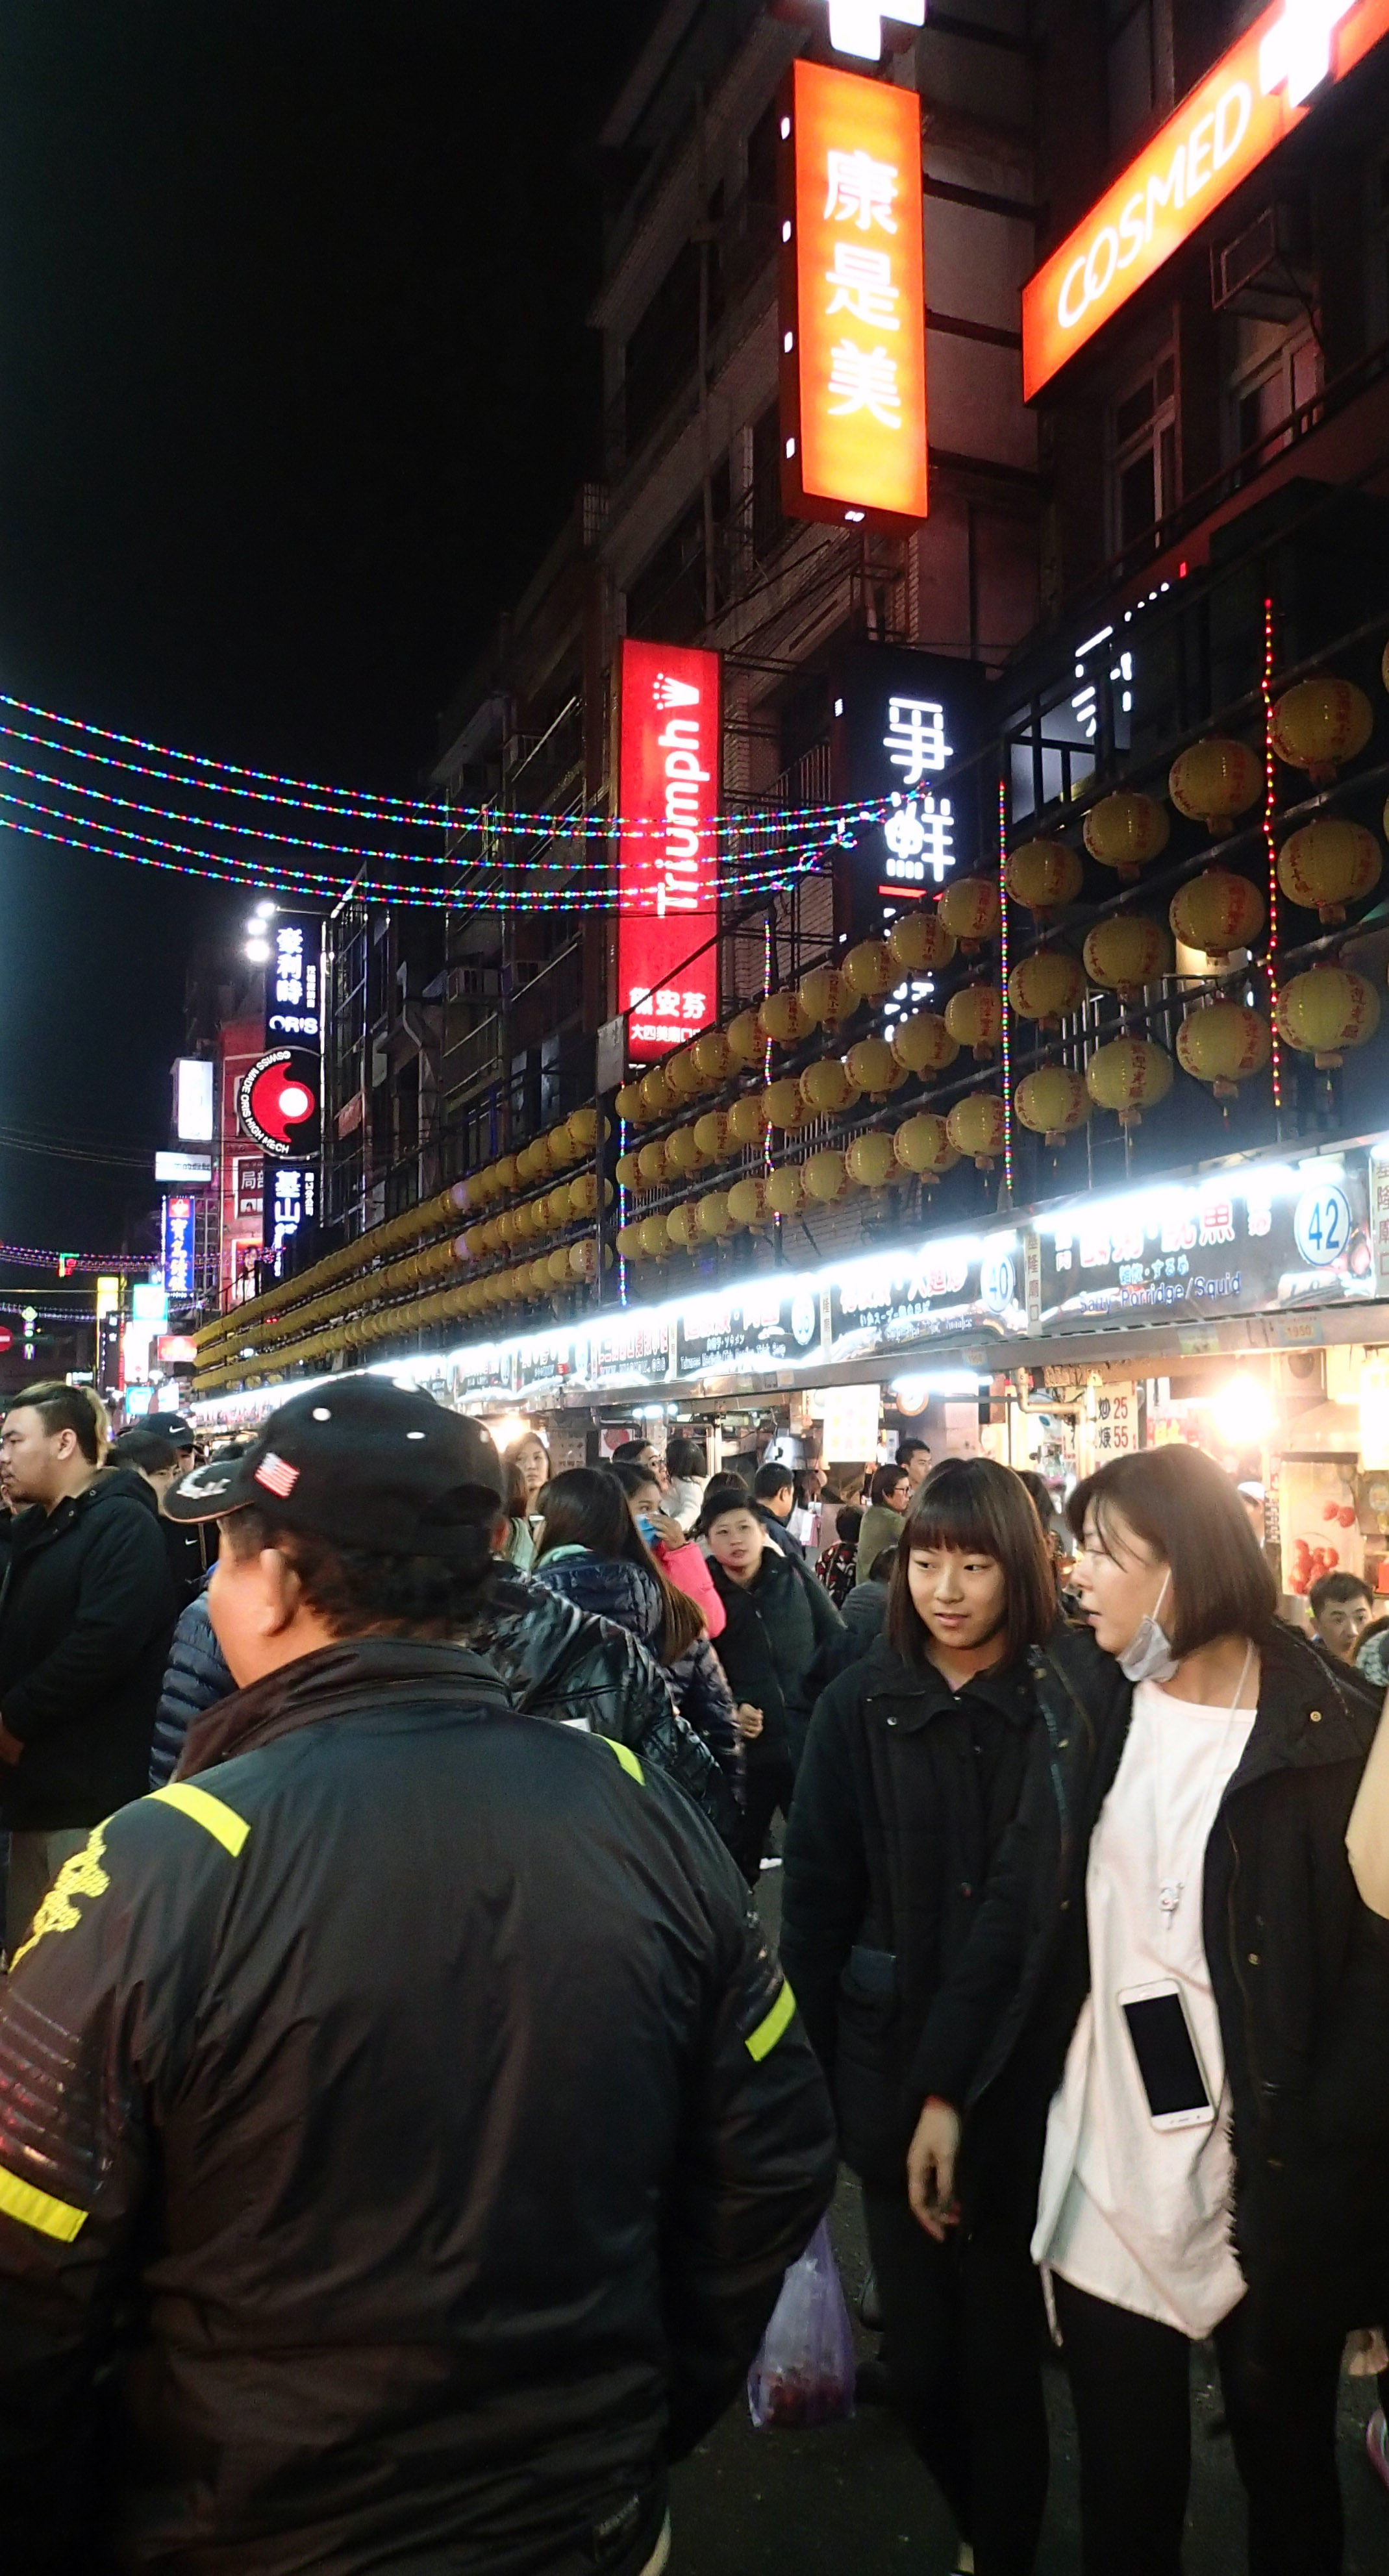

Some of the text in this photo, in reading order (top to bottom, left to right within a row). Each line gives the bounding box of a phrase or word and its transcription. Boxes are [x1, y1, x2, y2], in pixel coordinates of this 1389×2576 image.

[1058, 81, 1252, 328] COSMED
[823, 149, 902, 429] 康是美
[657, 719, 710, 919] Triumph
[269, 1015, 318, 1035] ORIS
[242, 1068, 260, 1094] MADE
[240, 1095, 251, 1118] ORIS
[245, 1117, 265, 1140] HIGH
[262, 1136, 290, 1154] MECH
[1308, 1198, 1340, 1250] 42
[989, 1262, 1008, 1300] 40
[1113, 1396, 1129, 1420] 25
[1113, 1426, 1129, 1448] 55
